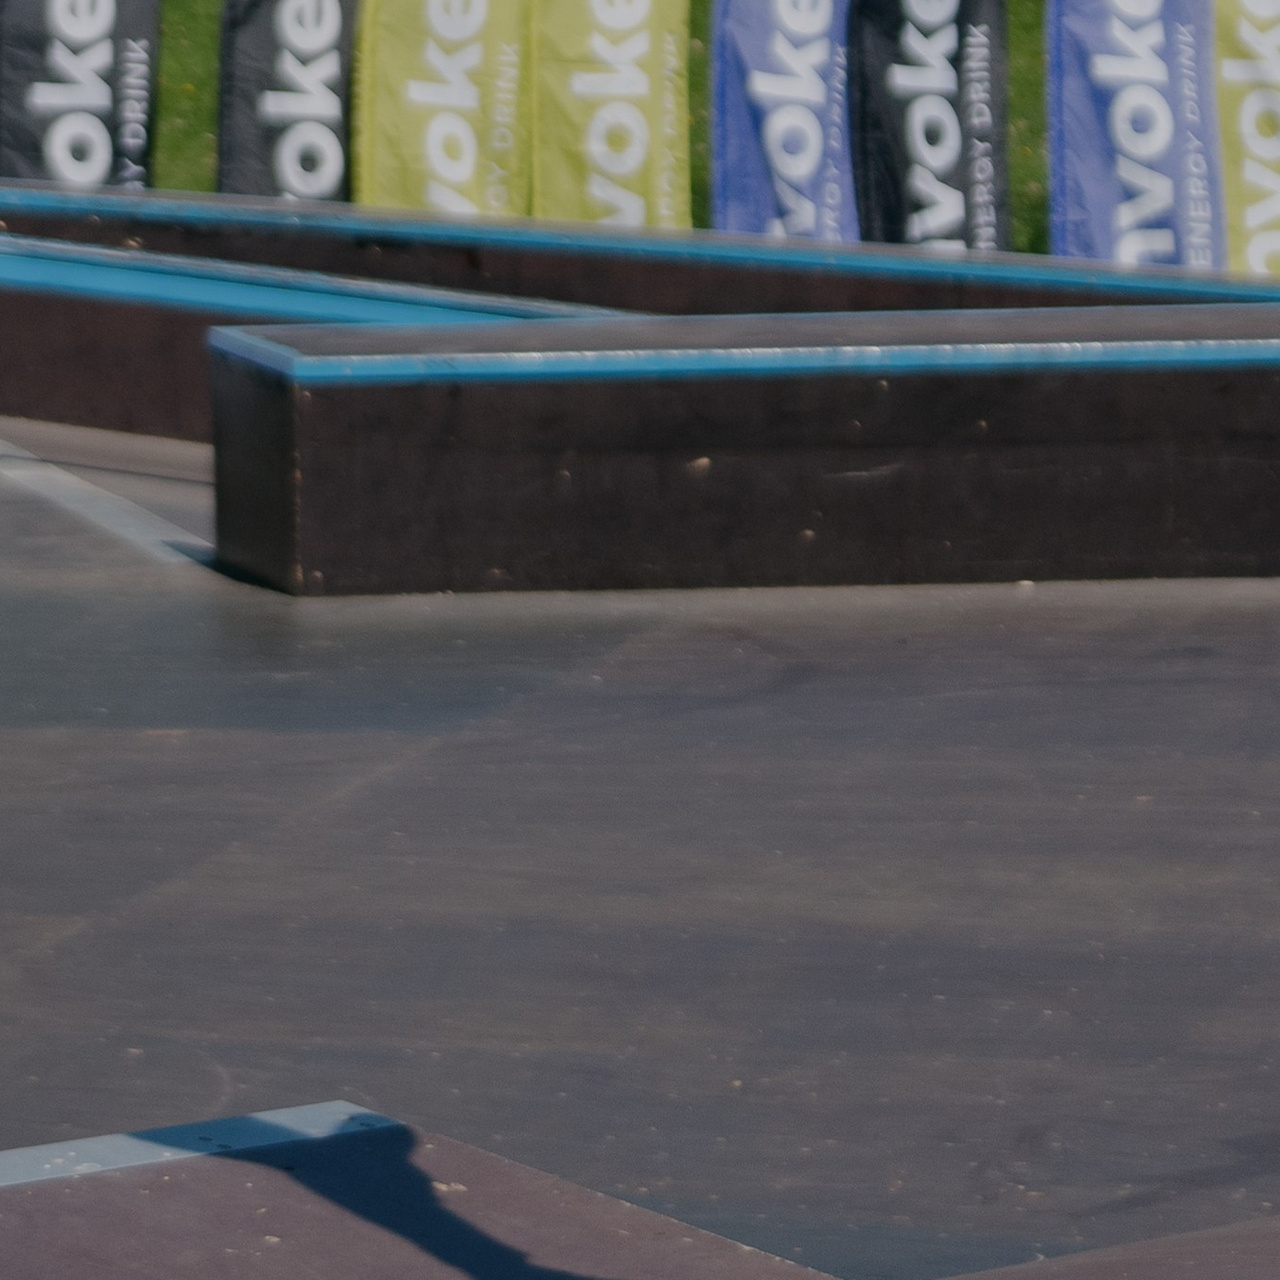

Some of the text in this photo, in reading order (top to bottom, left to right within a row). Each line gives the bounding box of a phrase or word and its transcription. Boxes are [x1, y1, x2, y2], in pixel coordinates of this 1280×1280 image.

[119, 38, 150, 147] DRINK
[490, 42, 519, 150] DRINK
[963, 22, 993, 126] DRINK
[1175, 22, 1213, 268] ENERGY DRINK
